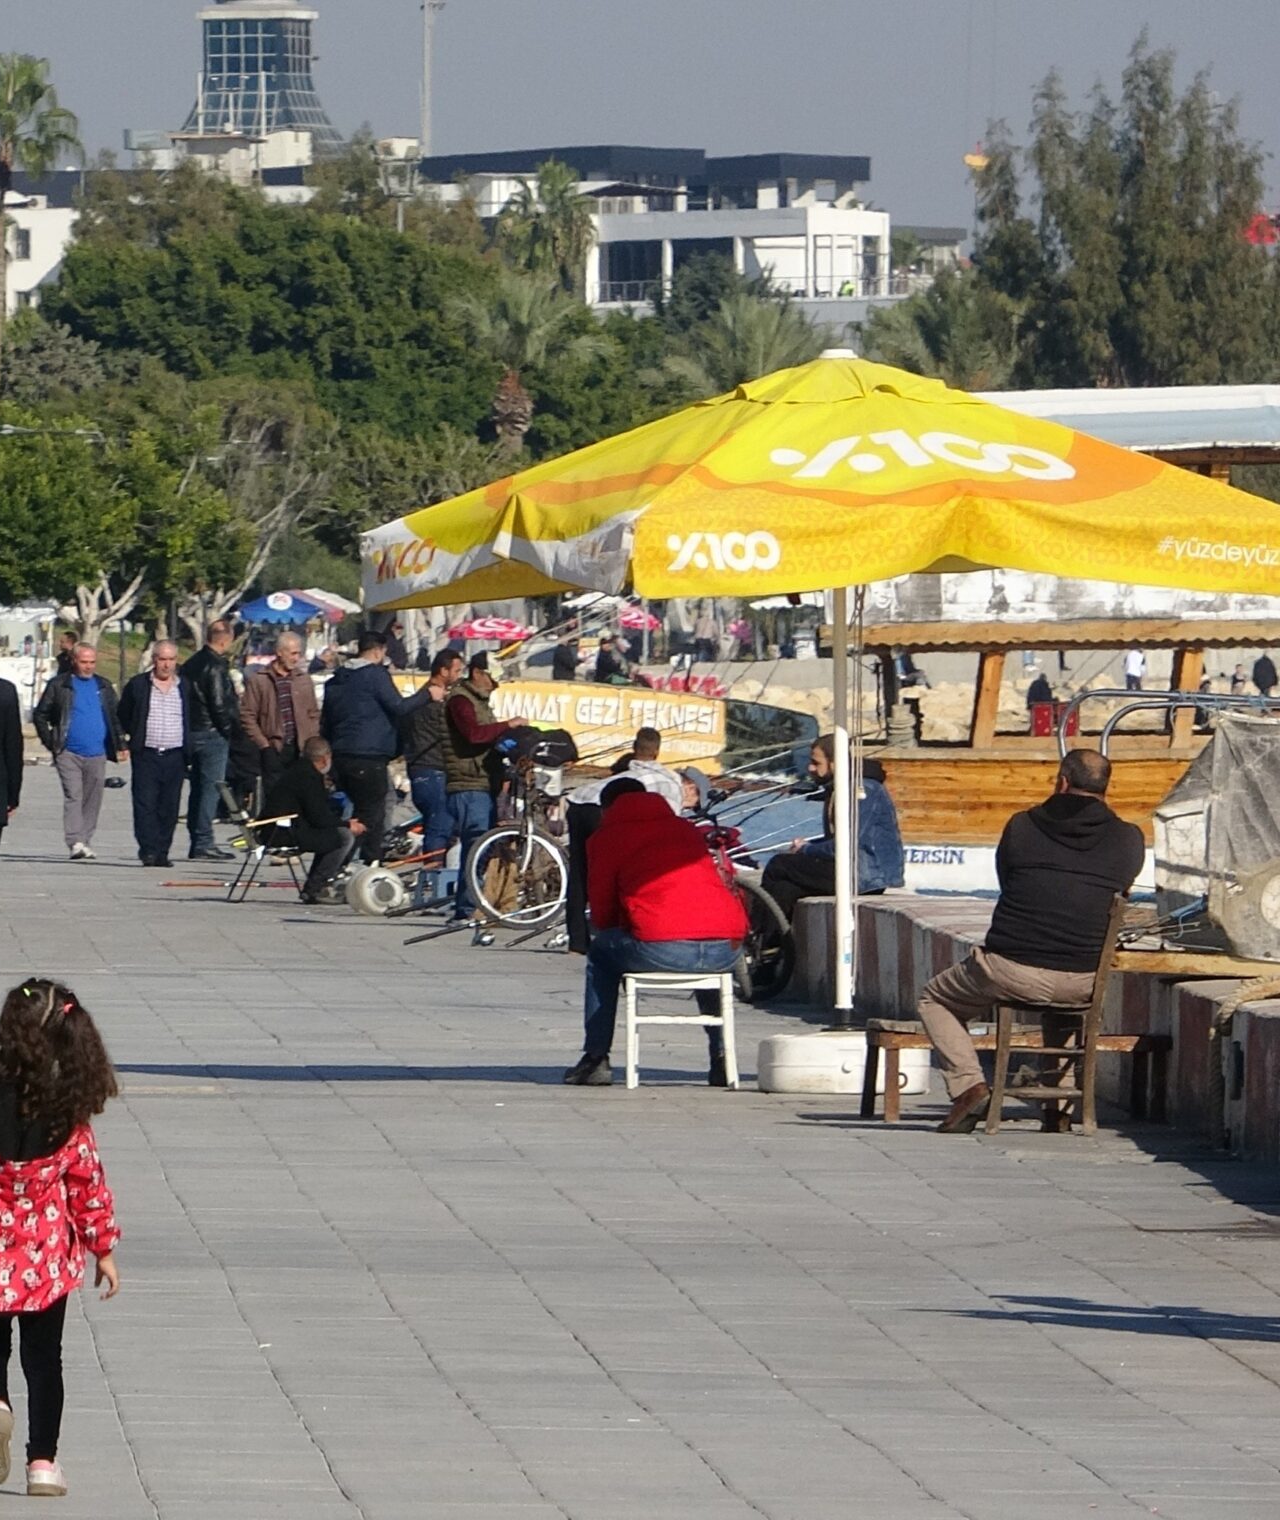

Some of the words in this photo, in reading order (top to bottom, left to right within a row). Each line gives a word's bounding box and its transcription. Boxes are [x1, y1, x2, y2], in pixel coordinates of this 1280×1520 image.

[769, 429, 1076, 481] %100
[666, 530, 781, 572] %100
[1157, 535, 1280, 567] #yüzdeyüz
[575, 693, 623, 727] GEZİ
[629, 698, 719, 734] TEKNESİ
